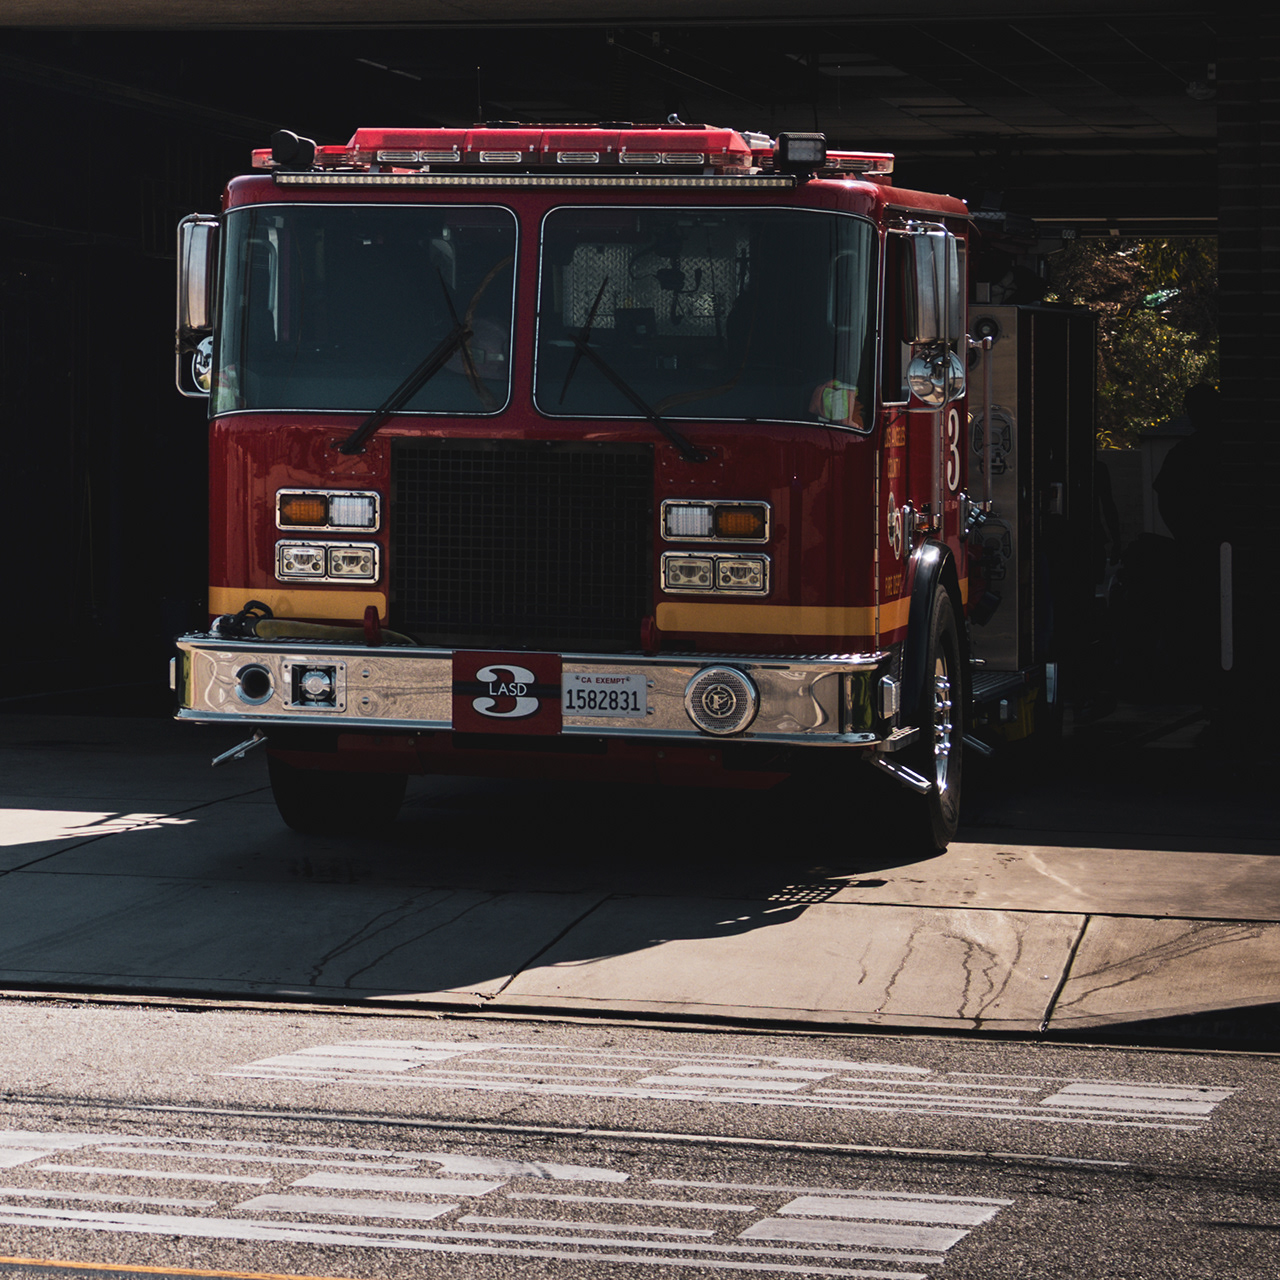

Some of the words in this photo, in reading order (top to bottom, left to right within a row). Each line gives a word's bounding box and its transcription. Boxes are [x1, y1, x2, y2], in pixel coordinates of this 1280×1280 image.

[946, 407, 960, 492] 3
[473, 664, 539, 718] 3
[490, 682, 527, 696] LASD
[596, 677, 625, 685] EXEMPT
[566, 688, 641, 711] 1582831
